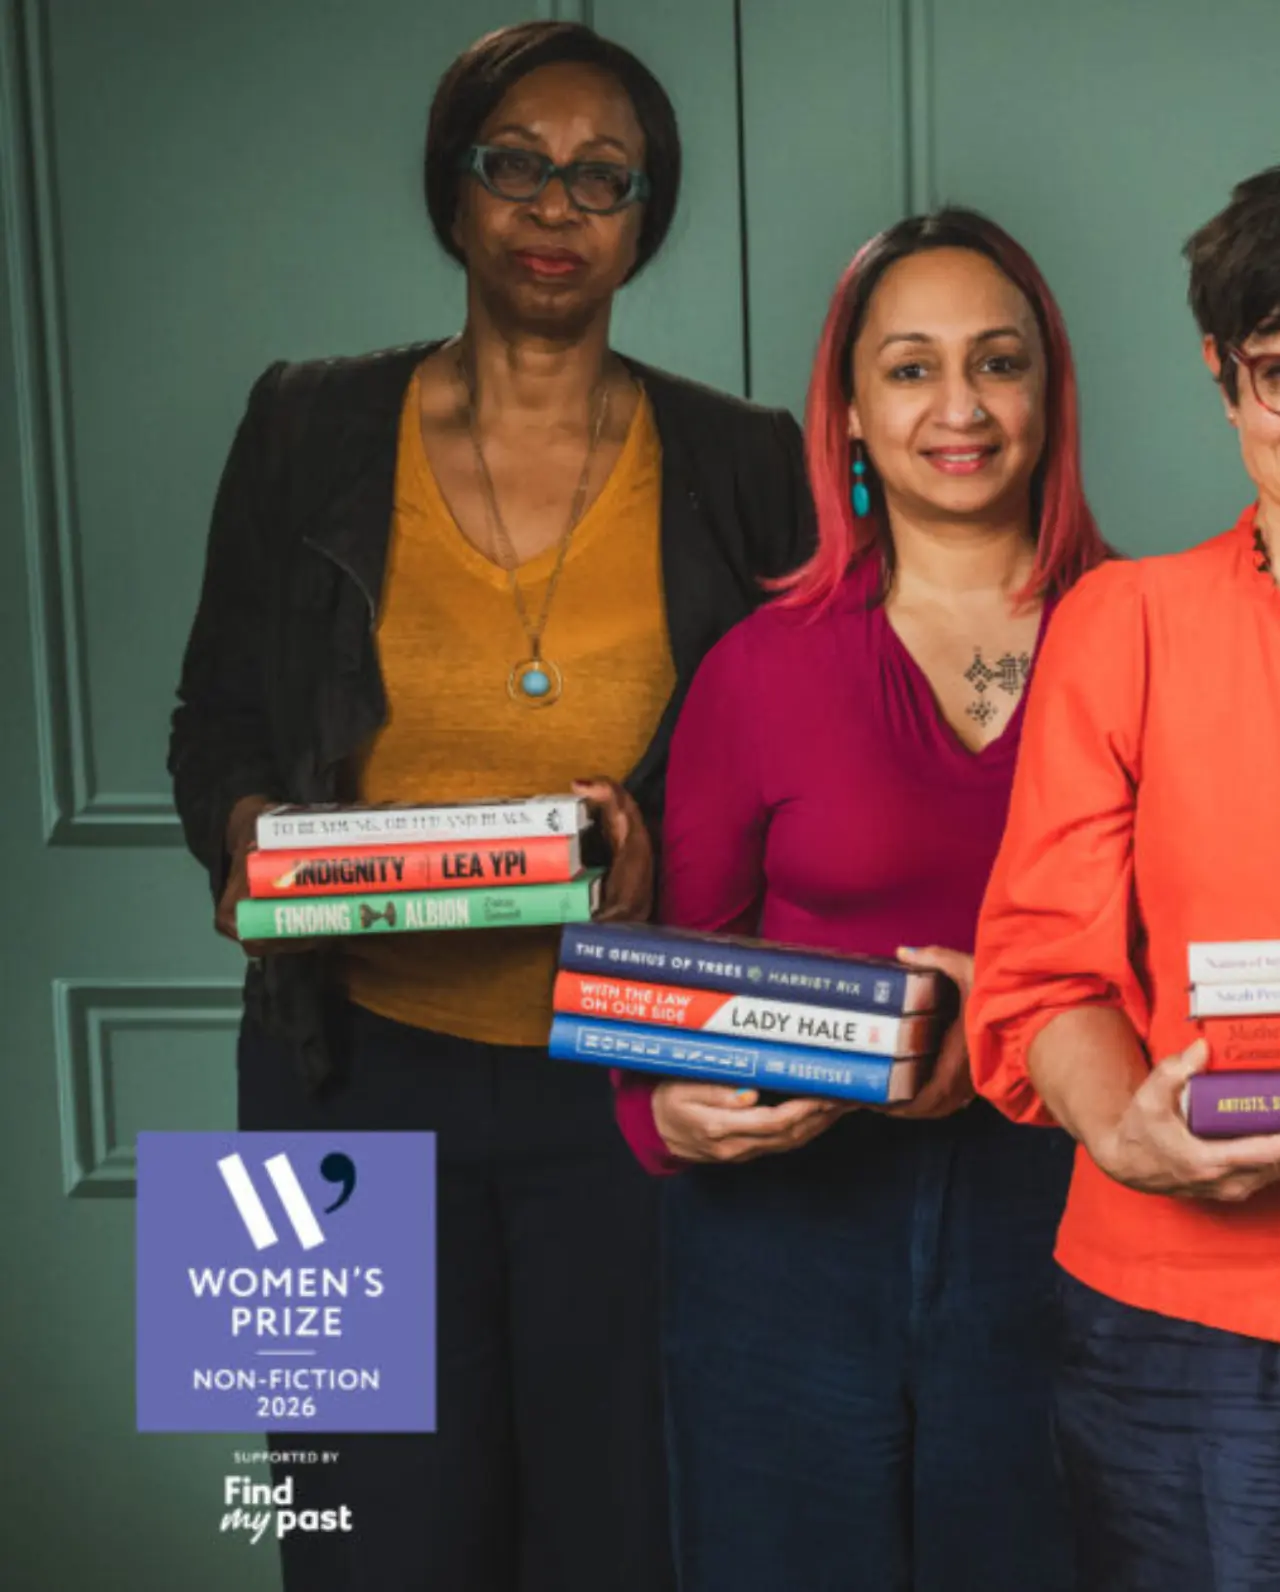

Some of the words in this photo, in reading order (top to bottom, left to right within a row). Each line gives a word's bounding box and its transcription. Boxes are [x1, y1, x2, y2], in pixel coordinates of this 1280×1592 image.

[294, 855, 405, 887] INDIGNITY
[442, 852, 484, 879] LEA
[489, 849, 526, 877] YPI
[275, 901, 352, 935] FINDING
[405, 896, 470, 929] ALBION
[576, 942, 603, 958] THE
[609, 948, 667, 967] GENIUS
[671, 956, 692, 970] OF
[697, 959, 743, 979] TREES
[580, 980, 621, 999] WITH
[625, 986, 653, 1005] THE
[656, 992, 694, 1008] LAW
[767, 971, 832, 990] HARRIET
[836, 979, 861, 997] RIX
[581, 996, 607, 1012] ON
[612, 1000, 647, 1018] OUR
[652, 1005, 686, 1023] SIDE
[731, 1006, 791, 1033] LADY
[797, 1016, 858, 1042] HALE
